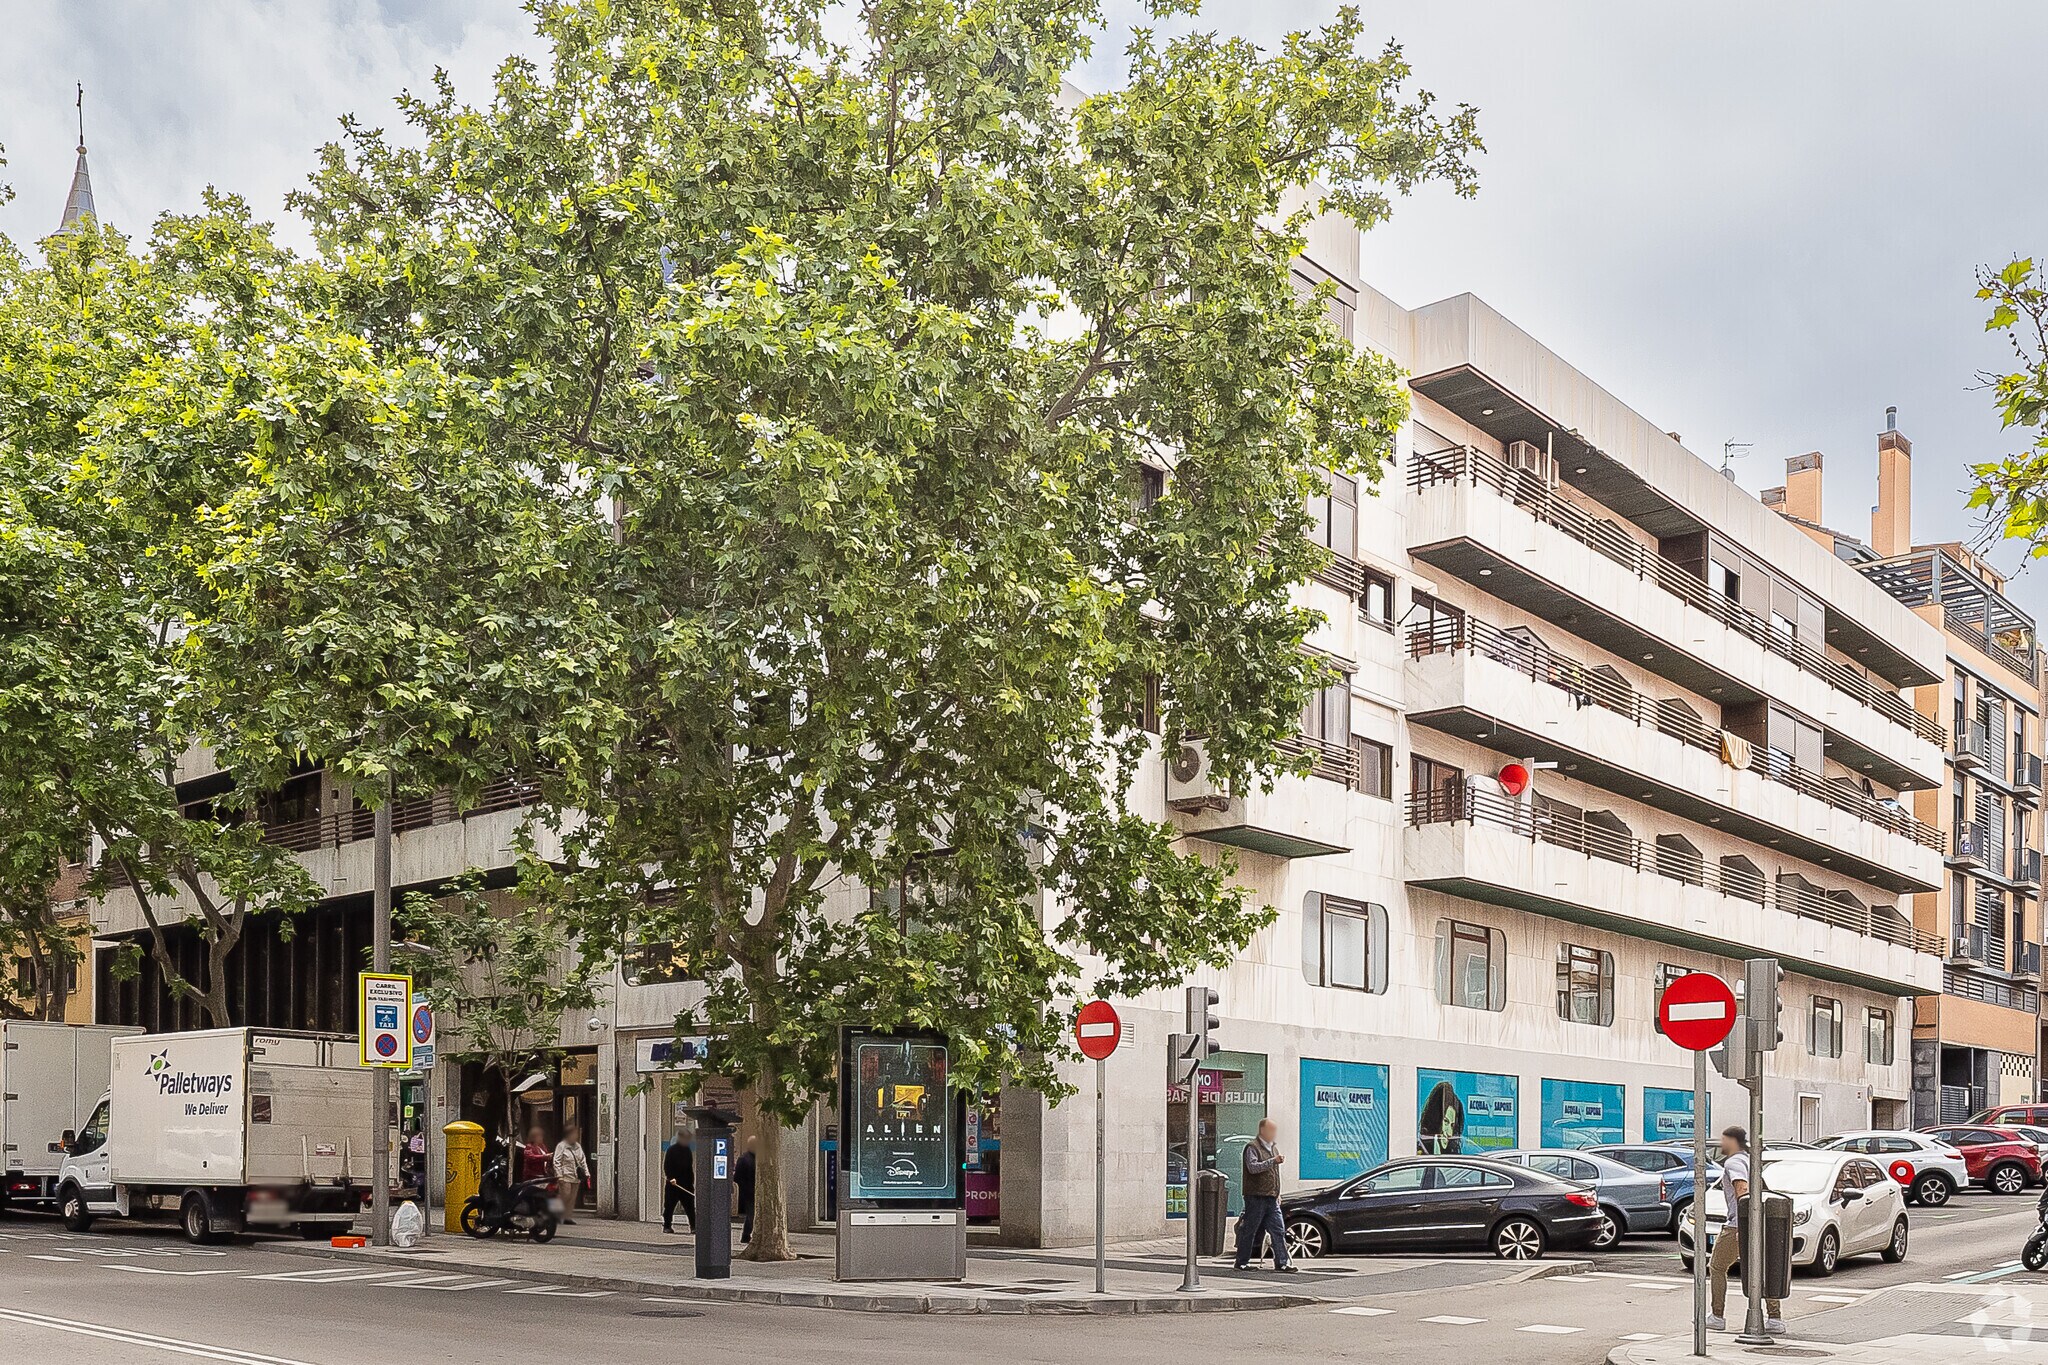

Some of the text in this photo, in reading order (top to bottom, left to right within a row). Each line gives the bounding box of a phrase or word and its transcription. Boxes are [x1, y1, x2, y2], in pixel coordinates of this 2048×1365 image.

[160, 1071, 232, 1098] Palletways
[1348, 1092, 1372, 1105] SAPONE
[184, 1102, 229, 1116] We Deliver
[1494, 1101, 1512, 1112] SAPONE
[866, 1121, 941, 1137] ALIEN
[716, 1140, 726, 1155] P
[965, 1190, 1000, 1200] PROM
